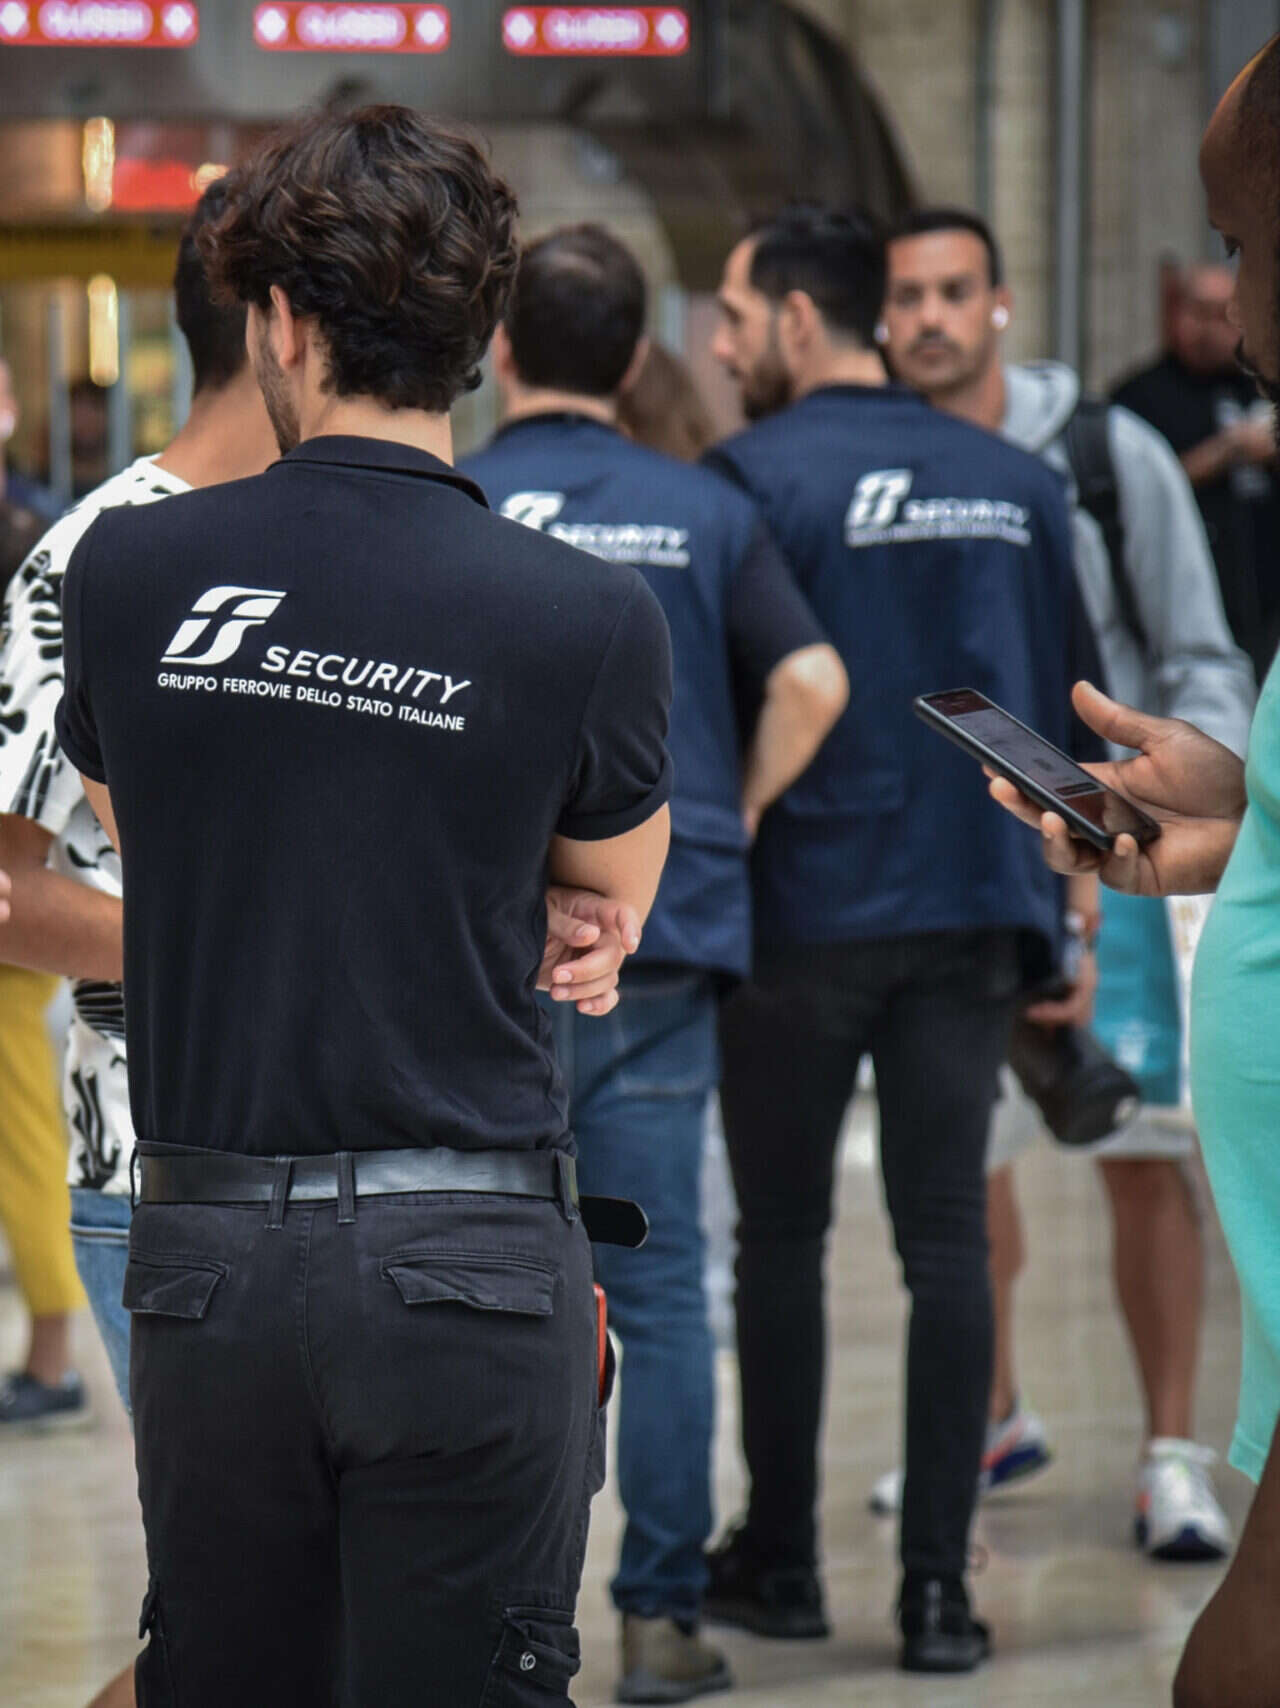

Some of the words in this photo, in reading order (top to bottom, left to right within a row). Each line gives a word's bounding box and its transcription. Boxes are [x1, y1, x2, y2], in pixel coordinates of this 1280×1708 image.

[157, 672, 218, 692] GRUPPO
[222, 677, 292, 699] FERROVIE
[295, 685, 342, 707] DELLO
[346, 695, 394, 717] STATO
[398, 705, 466, 731] ITALIANE
[260, 645, 472, 705] SECURITY
